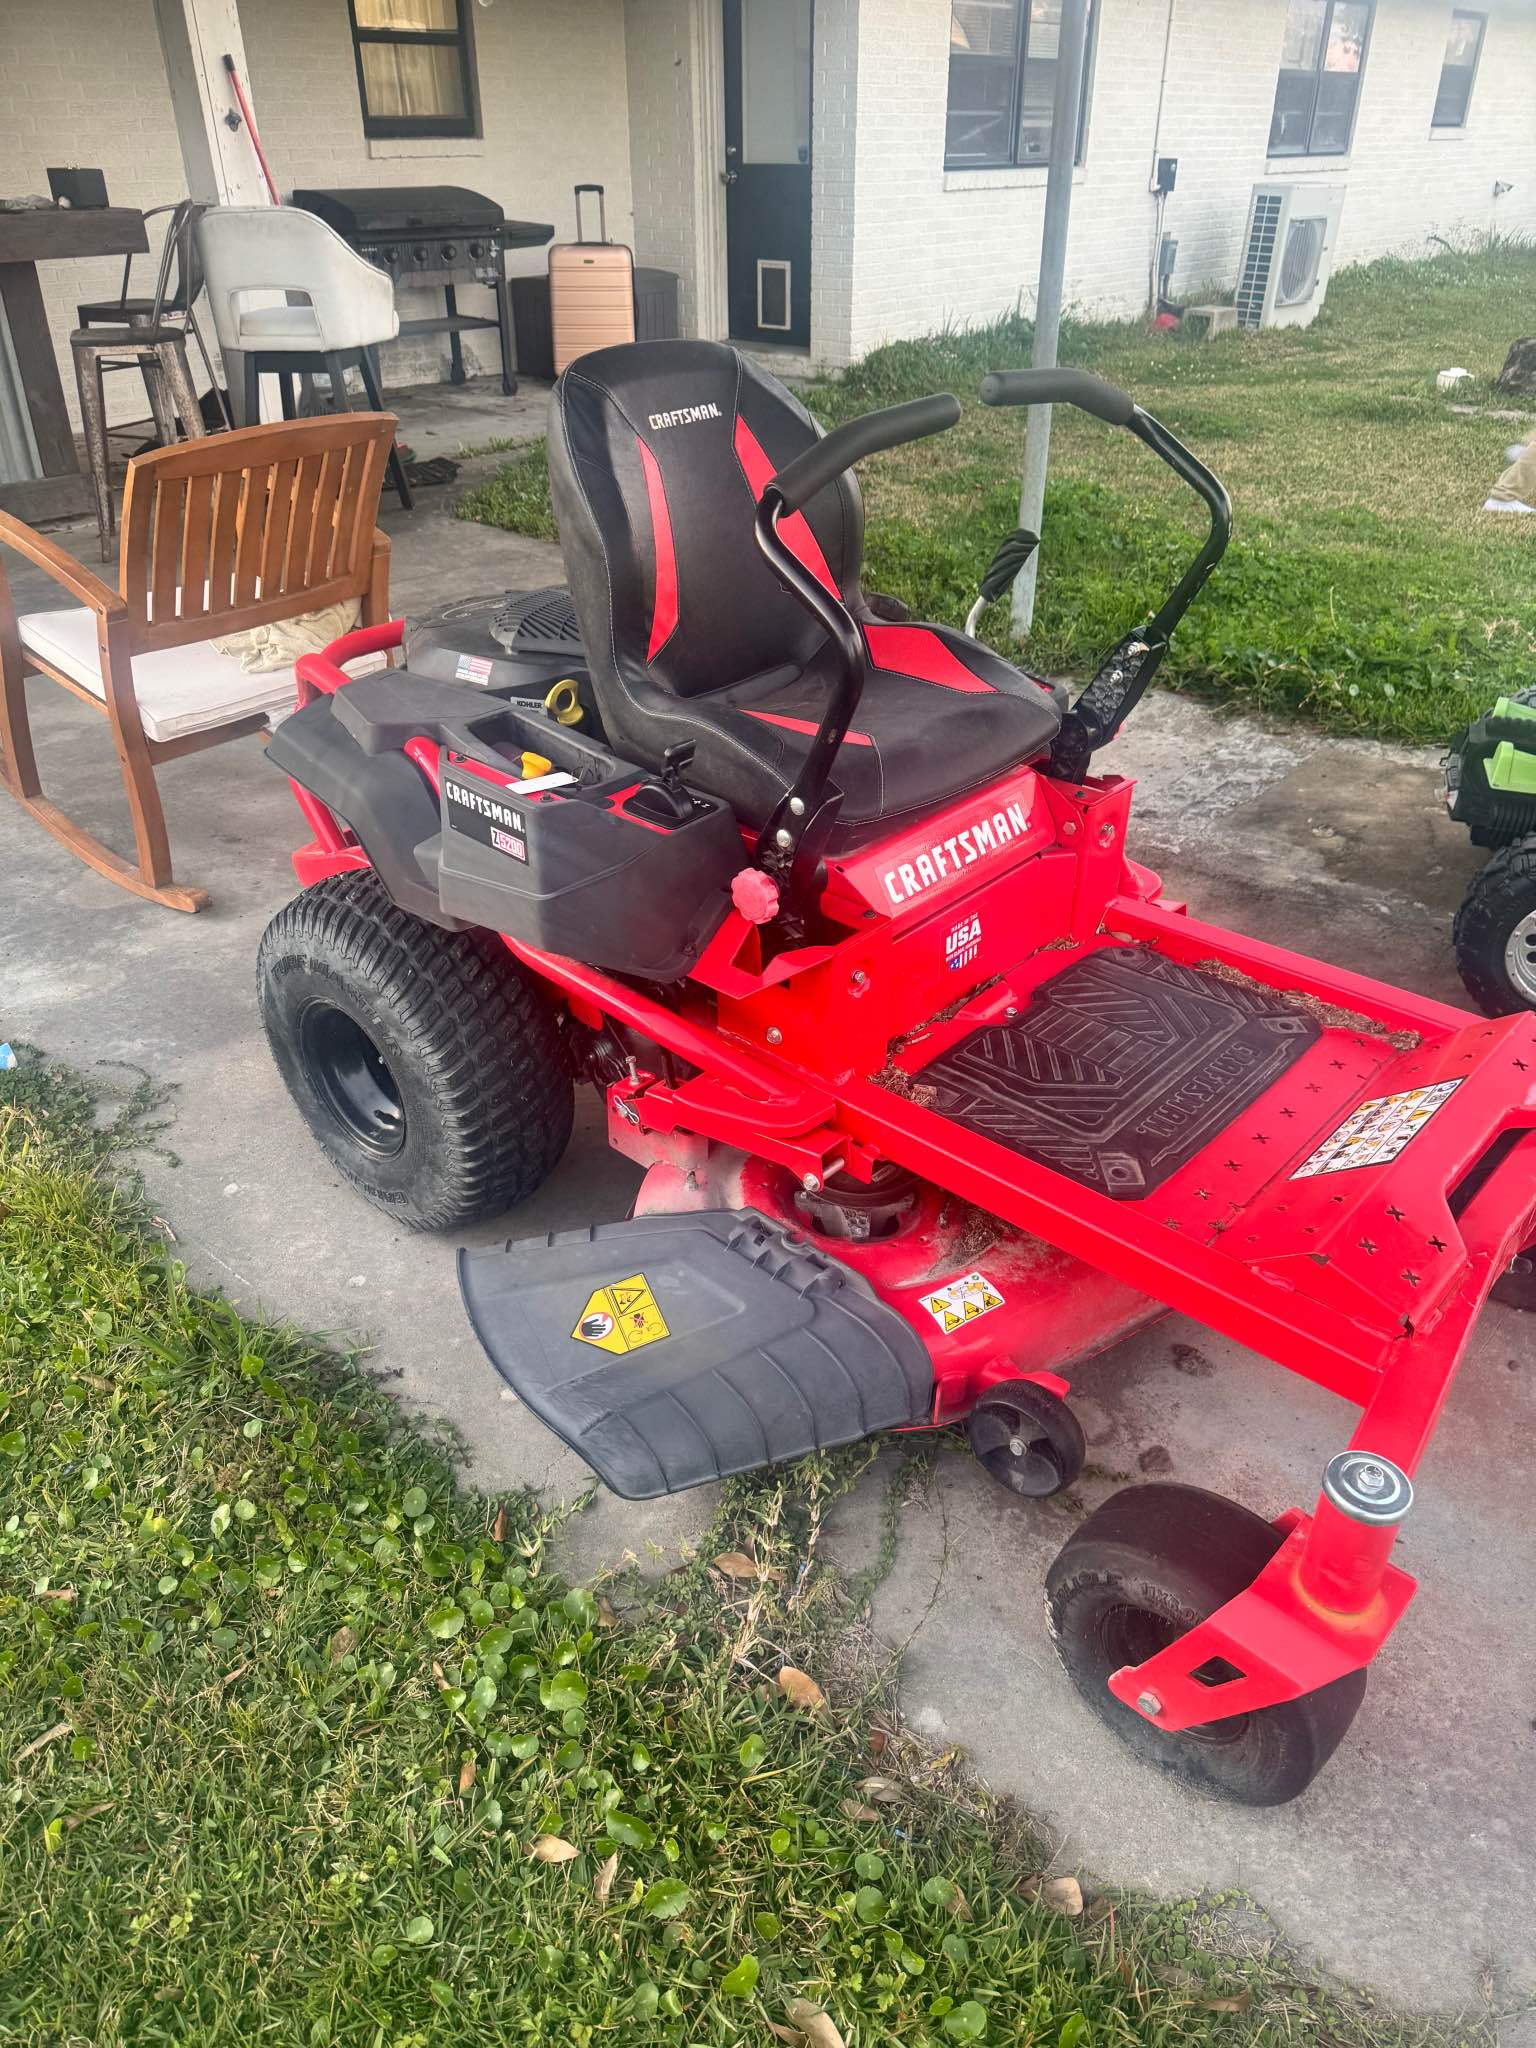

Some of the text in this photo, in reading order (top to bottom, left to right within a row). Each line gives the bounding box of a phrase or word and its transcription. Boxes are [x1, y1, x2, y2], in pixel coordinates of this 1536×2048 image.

[648, 402, 720, 430] CRAFTSMAN
[516, 700, 542, 709] KOHLER
[446, 781, 523, 833] CRAFTSMAN
[491, 829, 524, 860] Z5200
[884, 803, 1029, 904] CRAFTSMAN
[946, 918, 982, 955] USA
